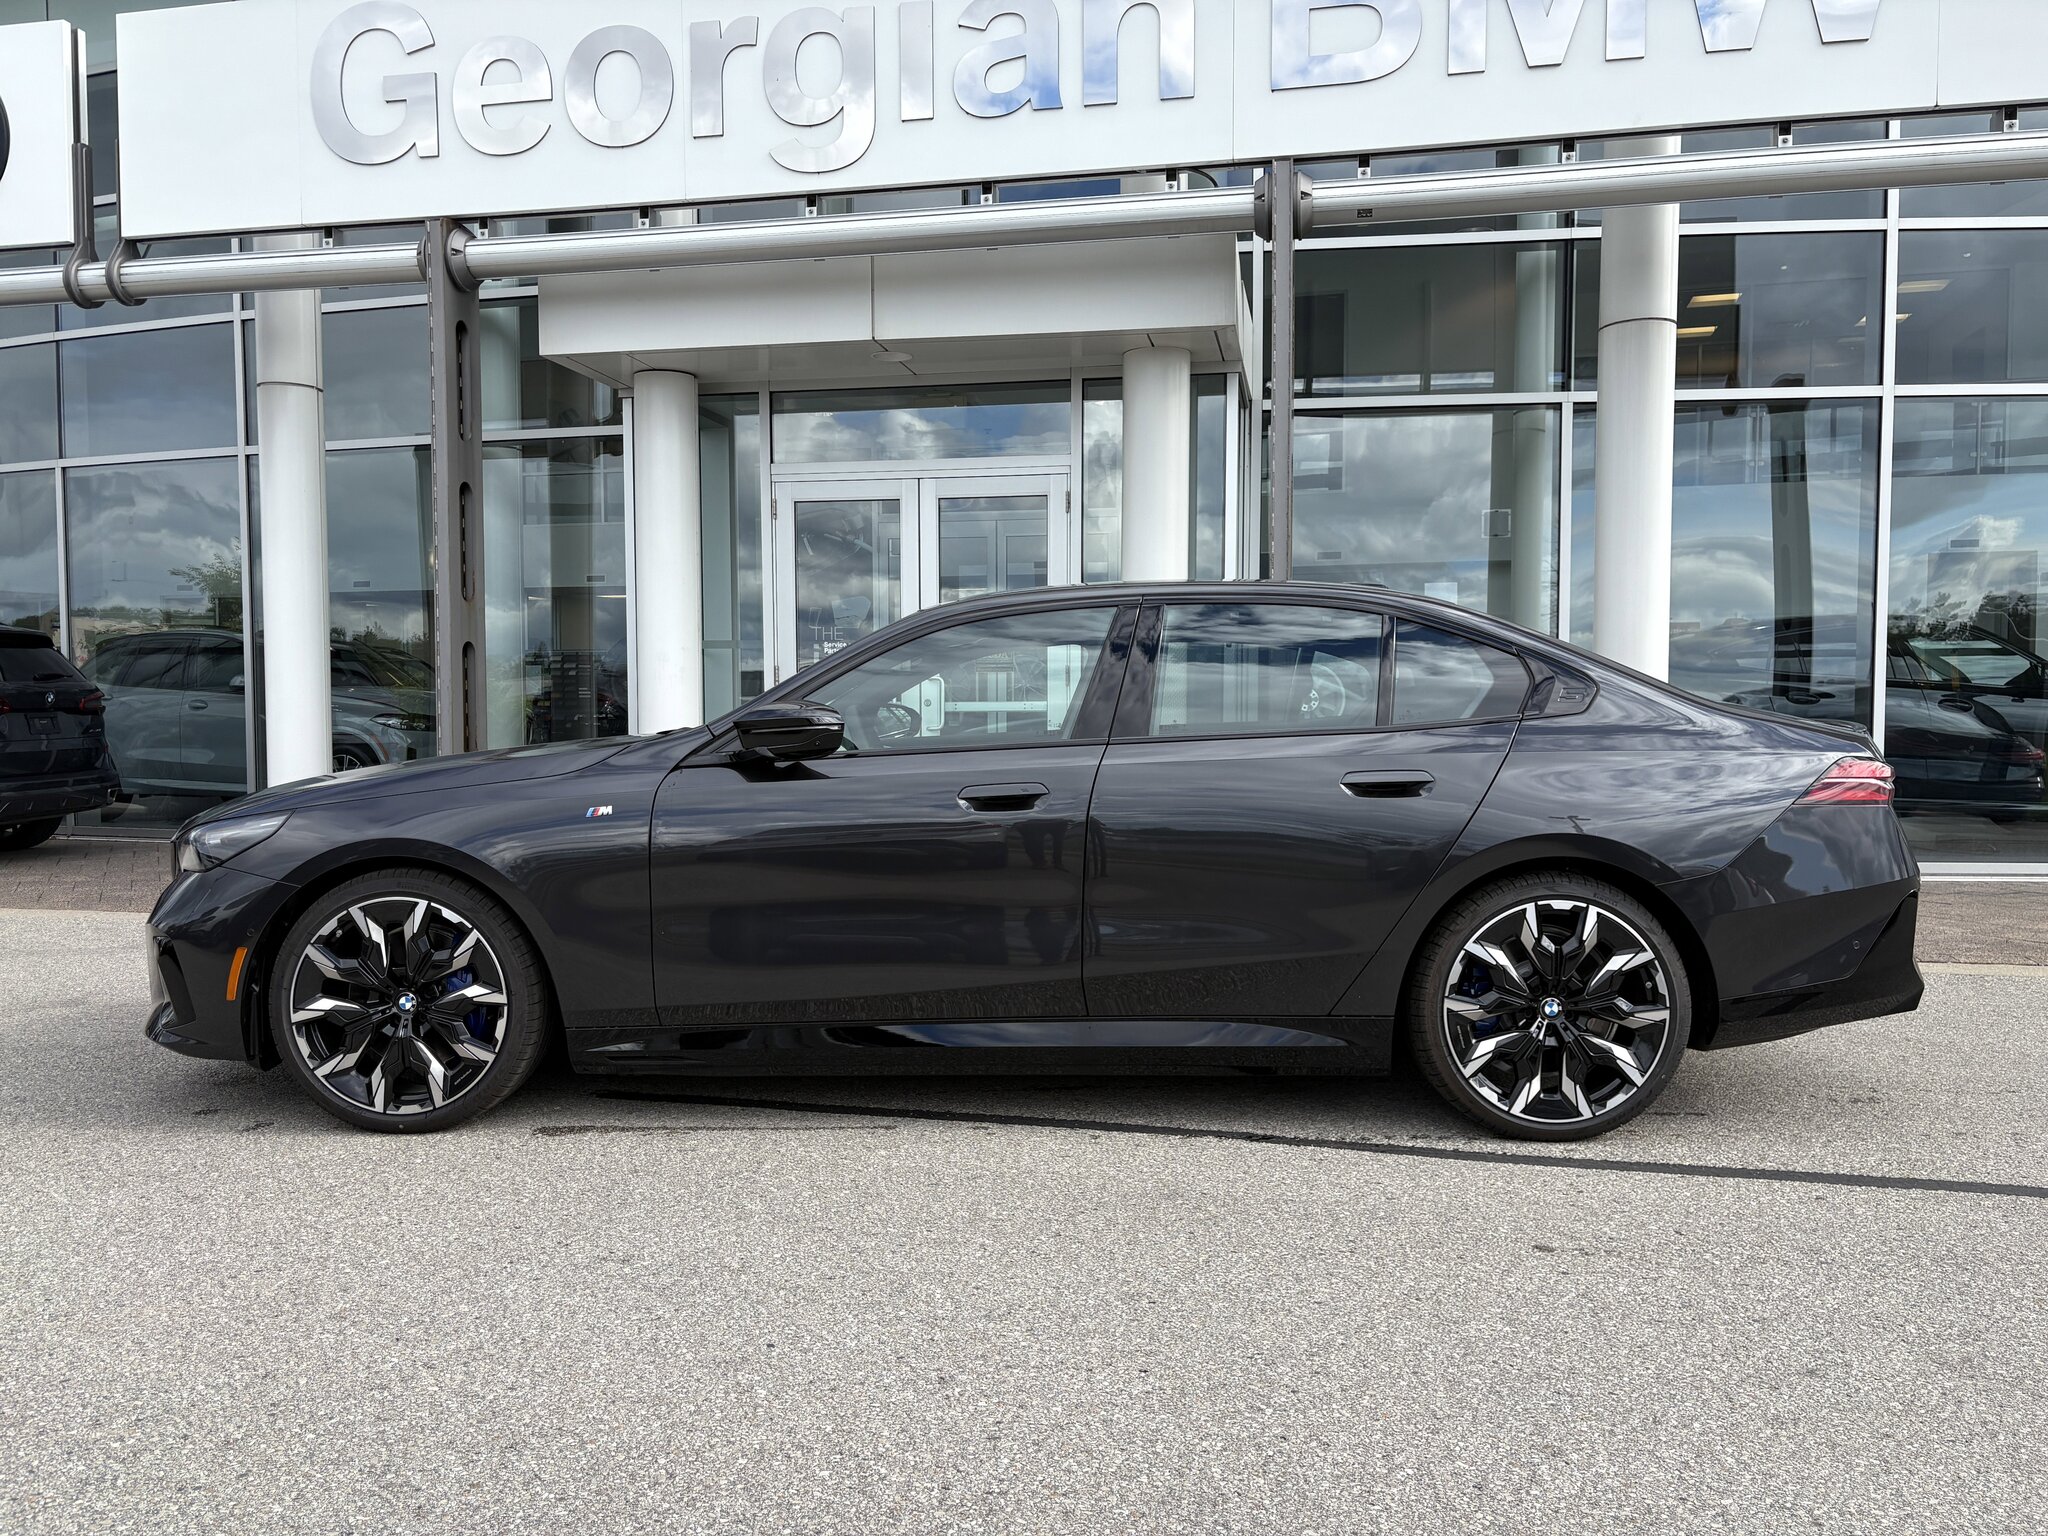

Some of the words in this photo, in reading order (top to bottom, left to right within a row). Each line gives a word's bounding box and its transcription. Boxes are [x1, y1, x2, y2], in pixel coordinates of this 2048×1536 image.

[310, 0, 1196, 174] Georgian
[810, 626, 844, 641] THE
[1557, 687, 1588, 704] 5
